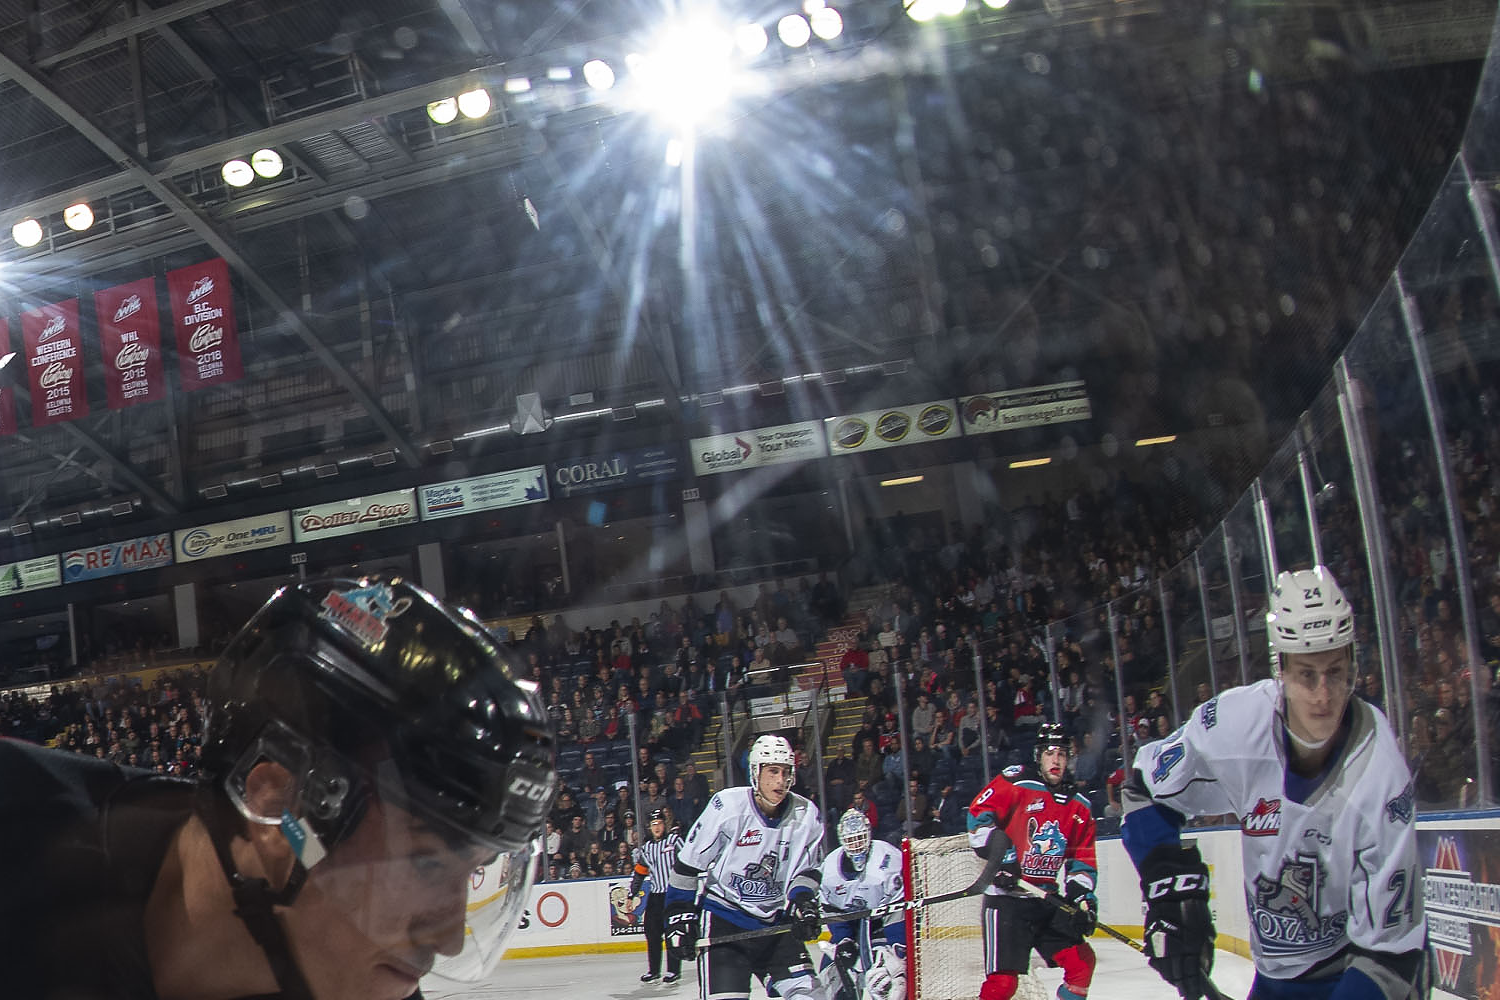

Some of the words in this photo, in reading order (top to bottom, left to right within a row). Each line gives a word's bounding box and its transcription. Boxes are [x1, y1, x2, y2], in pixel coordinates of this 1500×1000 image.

[194, 302, 212, 313] B.C.
[184, 308, 223, 325] DIVISION
[121, 331, 139, 343] WHL
[36, 339, 71, 355] WESTERN
[31, 347, 77, 367] CONFERENCE
[197, 351, 222, 365] 2018
[123, 368, 146, 381] 2015
[47, 387, 70, 400] 2015
[701, 446, 742, 464] Global
[759, 441, 783, 453] Your
[556, 457, 629, 486] CORAL
[301, 511, 358, 532] Dollar
[358, 503, 410, 523] Store
[189, 534, 225, 549] Image
[228, 531, 249, 542] One
[87, 541, 169, 570] RE/MAX
[1303, 587, 1322, 600] 24
[1301, 617, 1333, 631] CCM
[870, 899, 924, 917] CCM
